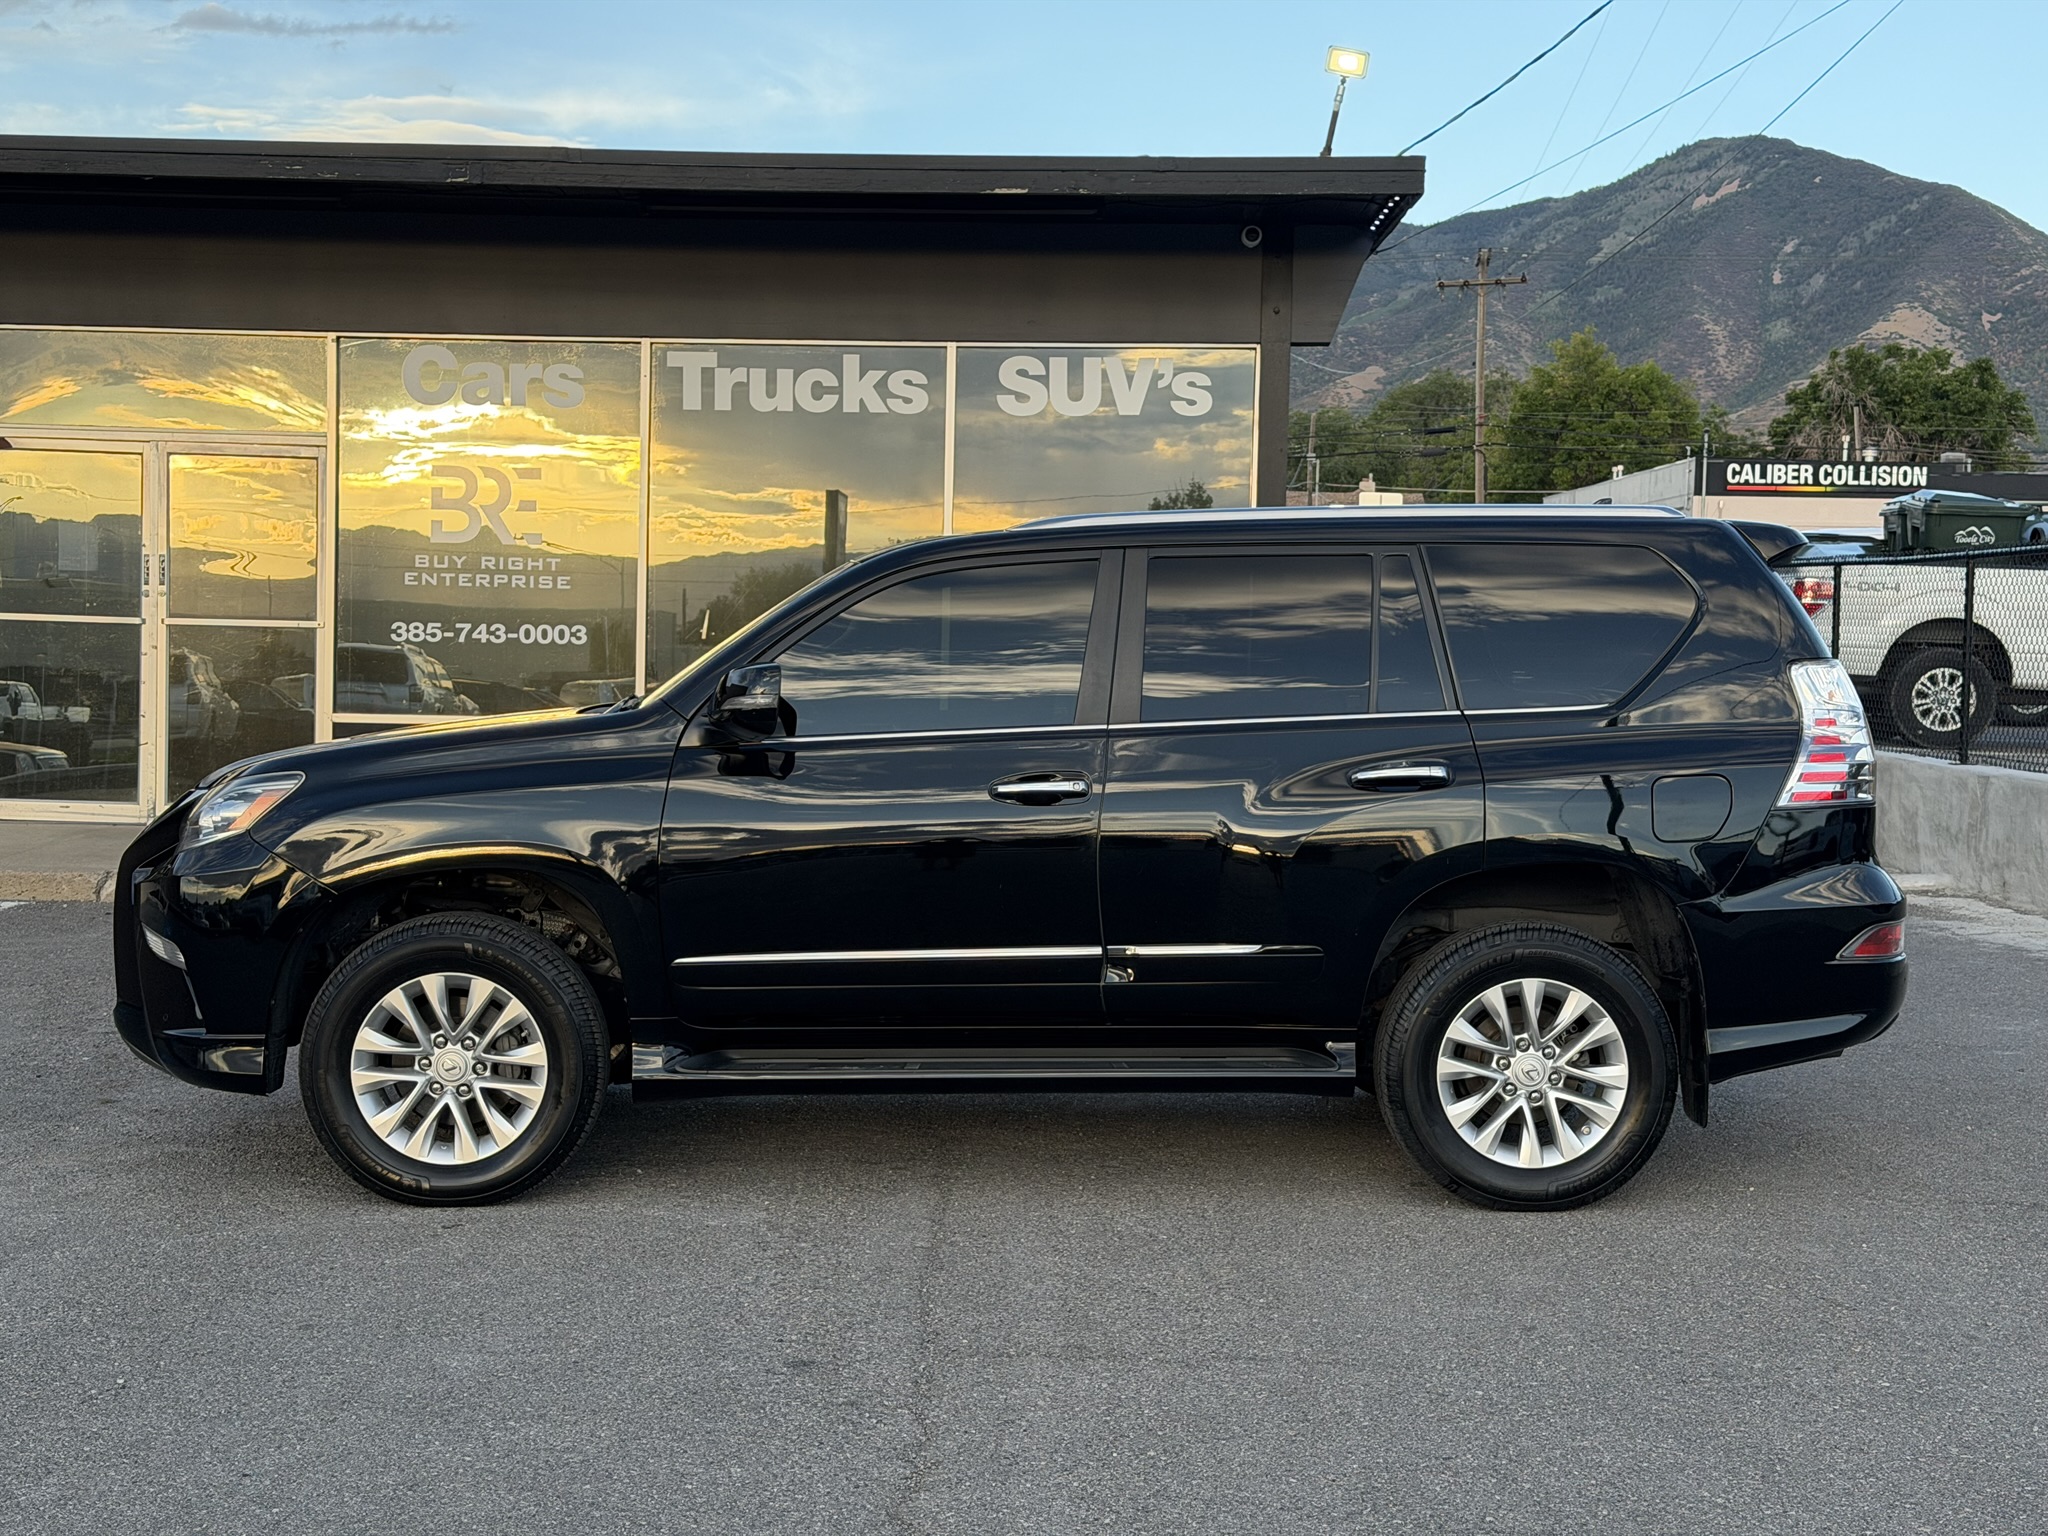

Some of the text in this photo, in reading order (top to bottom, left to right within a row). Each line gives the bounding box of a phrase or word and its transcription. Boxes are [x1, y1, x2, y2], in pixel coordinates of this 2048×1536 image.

[402, 345, 586, 409] Cars
[667, 351, 929, 415] Trucks
[996, 355, 1213, 417] SUV's
[1726, 463, 1928, 487] CALIBER COLLISION
[430, 464, 543, 546] BRE
[1979, 533, 1996, 545] City
[414, 554, 561, 571] BUY RIGHT
[404, 572, 571, 589] ENTERPRISE
[390, 621, 588, 645] 385-743-0003
